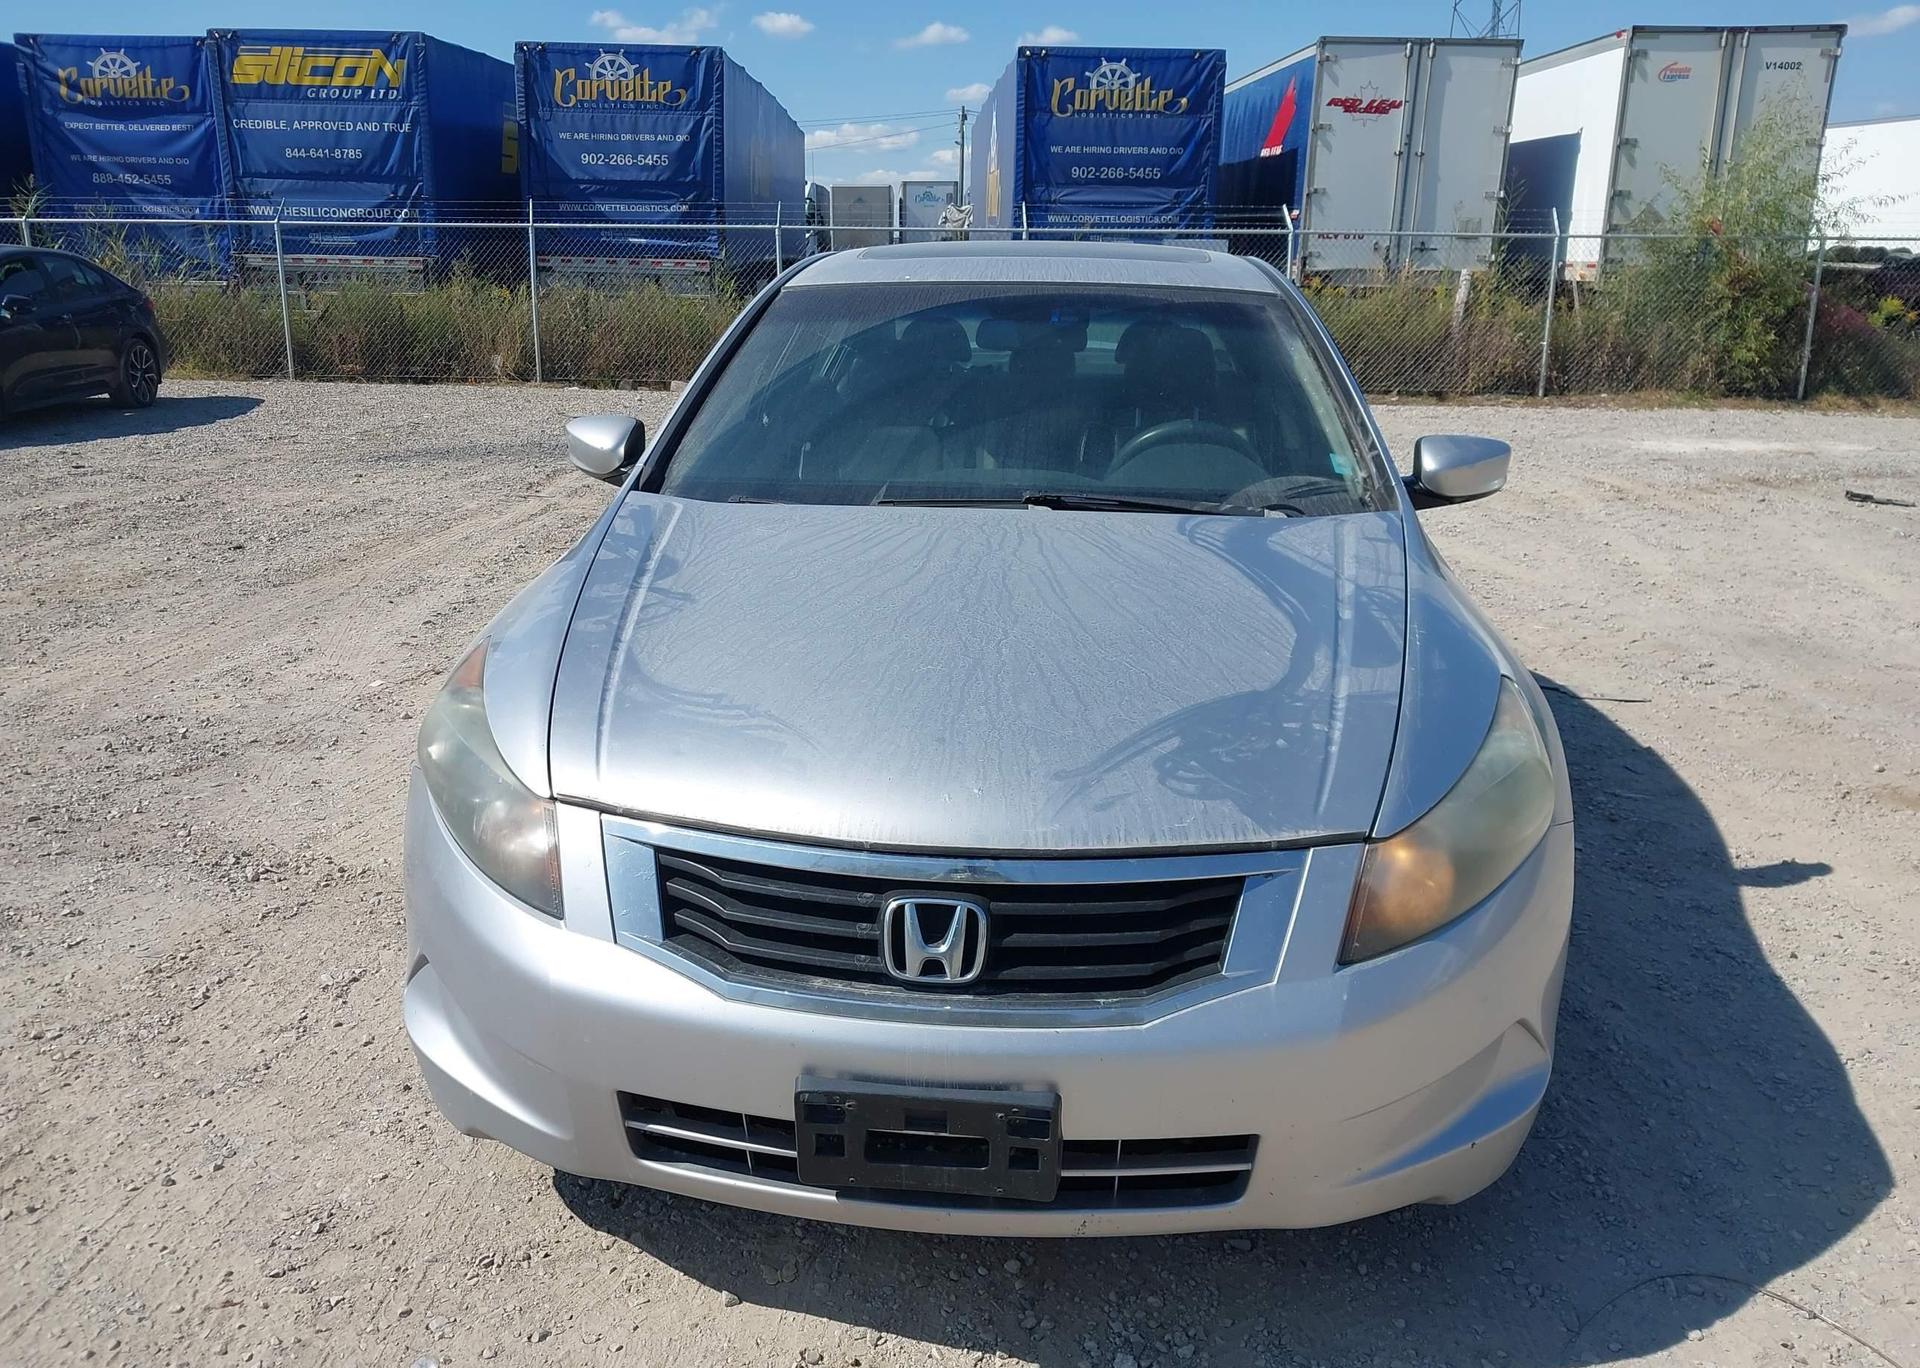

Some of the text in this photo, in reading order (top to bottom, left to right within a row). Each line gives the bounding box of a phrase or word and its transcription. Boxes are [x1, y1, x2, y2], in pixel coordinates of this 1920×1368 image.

[1765, 61, 1803, 71] V14002
[306, 87, 403, 100] GROUP LTD.
[554, 67, 687, 107] Corvette
[1051, 76, 1189, 117] Corvette
[1074, 111, 1134, 119] LOGISTICS
[64, 121, 94, 130] EXPECT
[128, 123, 171, 132] DELIVERED
[232, 118, 413, 133] CREDIBLE, APPROVED AND TRUE
[558, 132, 572, 140] WE
[572, 132, 590, 140] ARE
[590, 133, 620, 141] HIRING
[620, 133, 656, 142] DRIVERS
[656, 134, 675, 142] AND
[284, 147, 364, 160] 844-641-8785
[1050, 145, 1063, 153] WE
[1064, 145, 1081, 154] ARE
[1082, 146, 1112, 154] HIRING
[1113, 146, 1149, 155] DRIVERS
[1150, 146, 1168, 155] AND
[98, 155, 125, 163] HIRING
[125, 156, 157, 165] DRIVERS
[158, 156, 175, 165] AND
[580, 152, 670, 166] 902-266-5455
[92, 172, 172, 185] 888-452-5455
[1071, 166, 1162, 179] 902-266-5455
[559, 203, 690, 213] WWW.CORVETTELOGISTICS.COM
